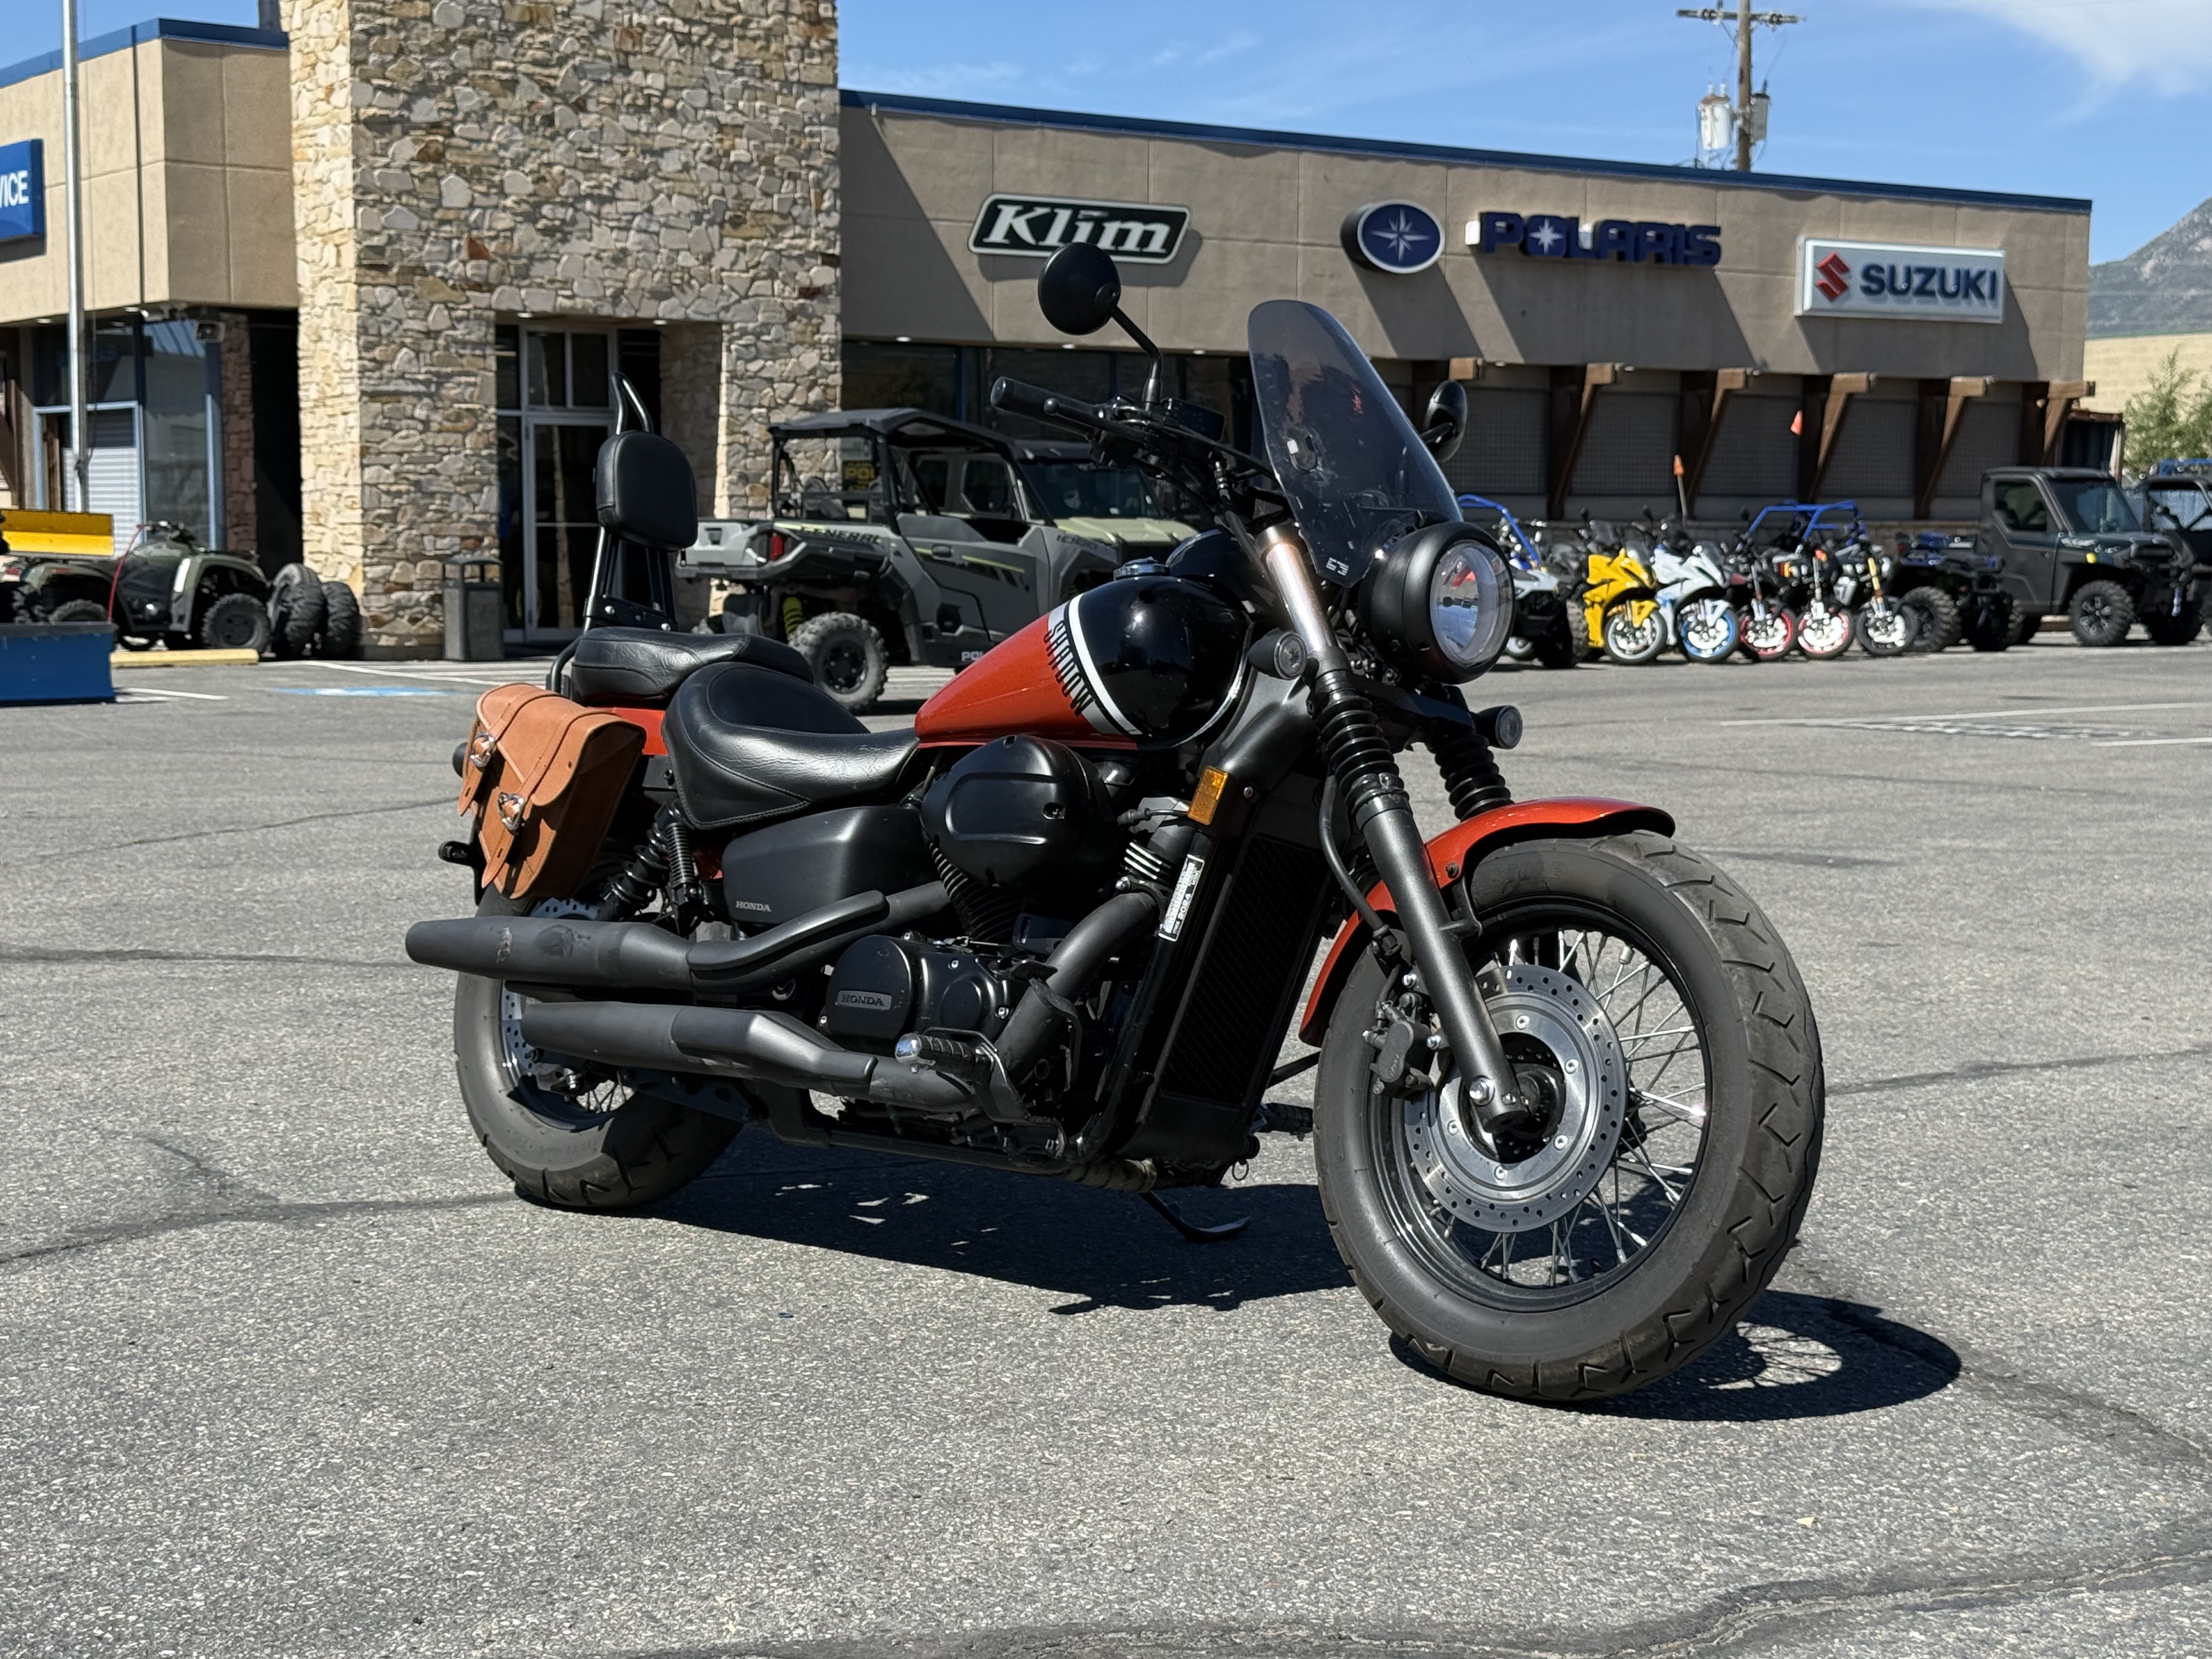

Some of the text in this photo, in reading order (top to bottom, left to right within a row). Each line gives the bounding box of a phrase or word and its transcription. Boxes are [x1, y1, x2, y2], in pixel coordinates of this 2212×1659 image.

[1480, 212, 1721, 266] POLARIS
[1860, 263, 1997, 301] SUZUKI
[1043, 619, 1094, 717] SHADOW
[735, 900, 771, 912] HONDA
[842, 994, 885, 1007] HONDA
